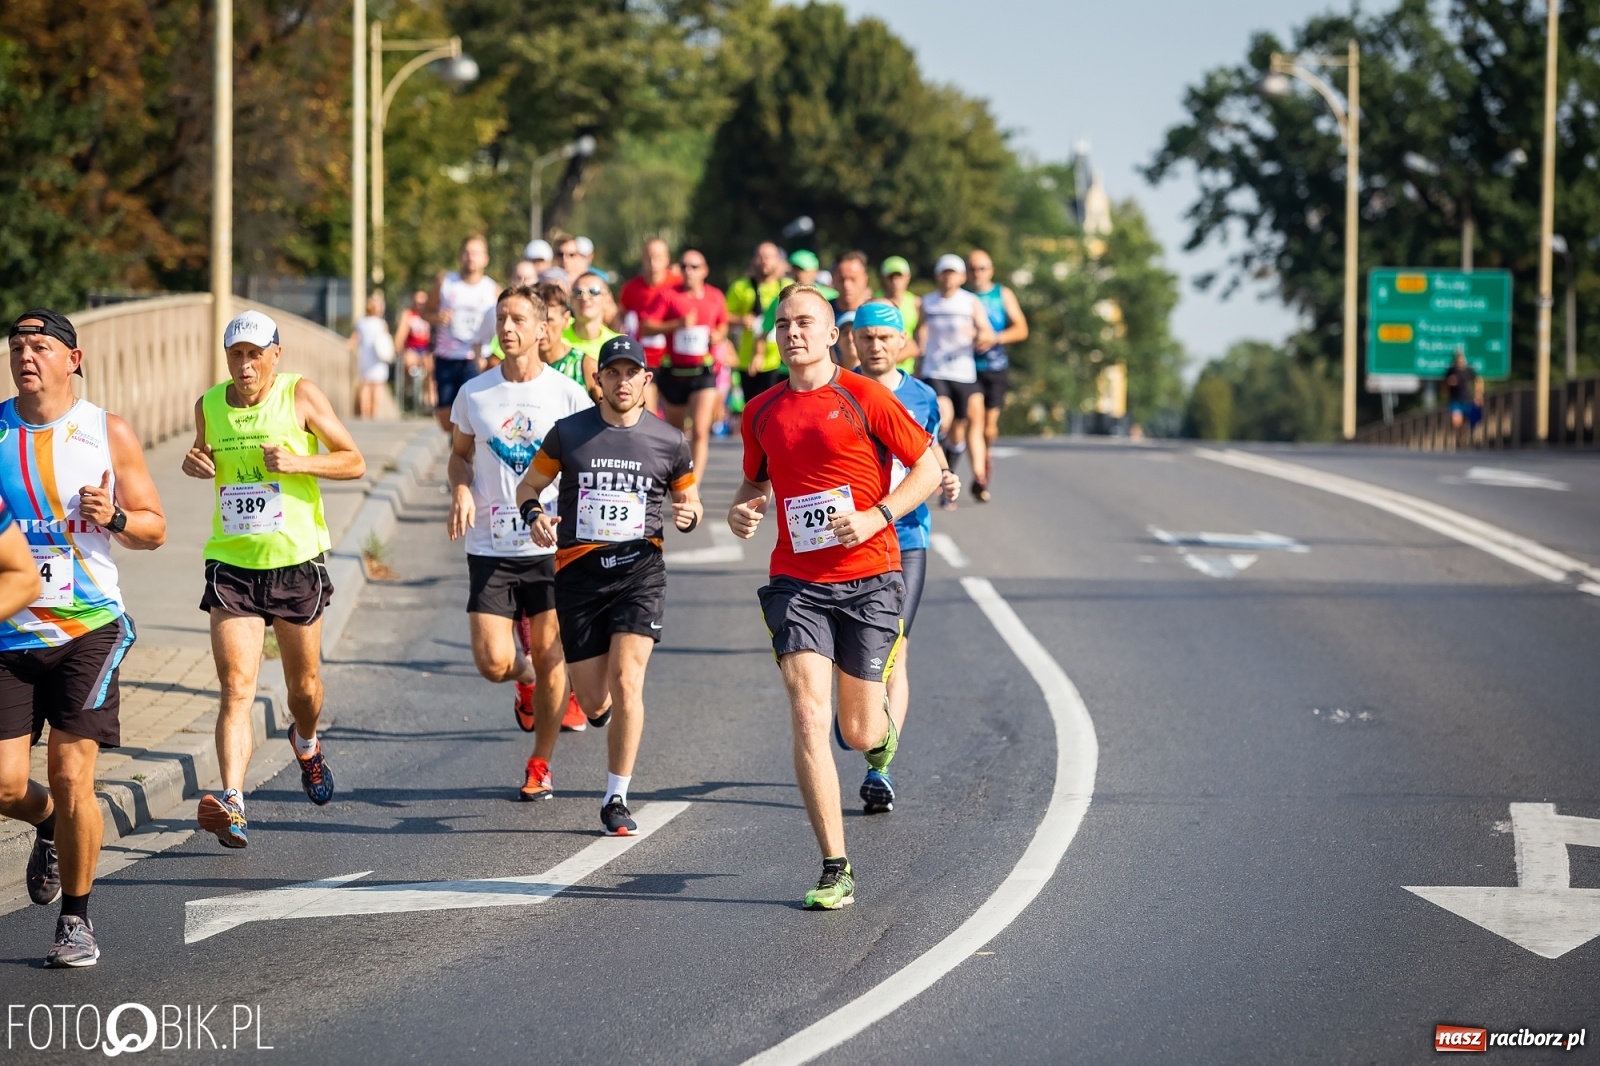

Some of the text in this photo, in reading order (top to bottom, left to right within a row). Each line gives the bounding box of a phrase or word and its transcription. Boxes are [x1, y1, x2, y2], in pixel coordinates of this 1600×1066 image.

[591, 458, 642, 471] LIVECHAT
[236, 497, 266, 514] 389
[600, 504, 629, 521] 133
[600, 554, 617, 569] UE
